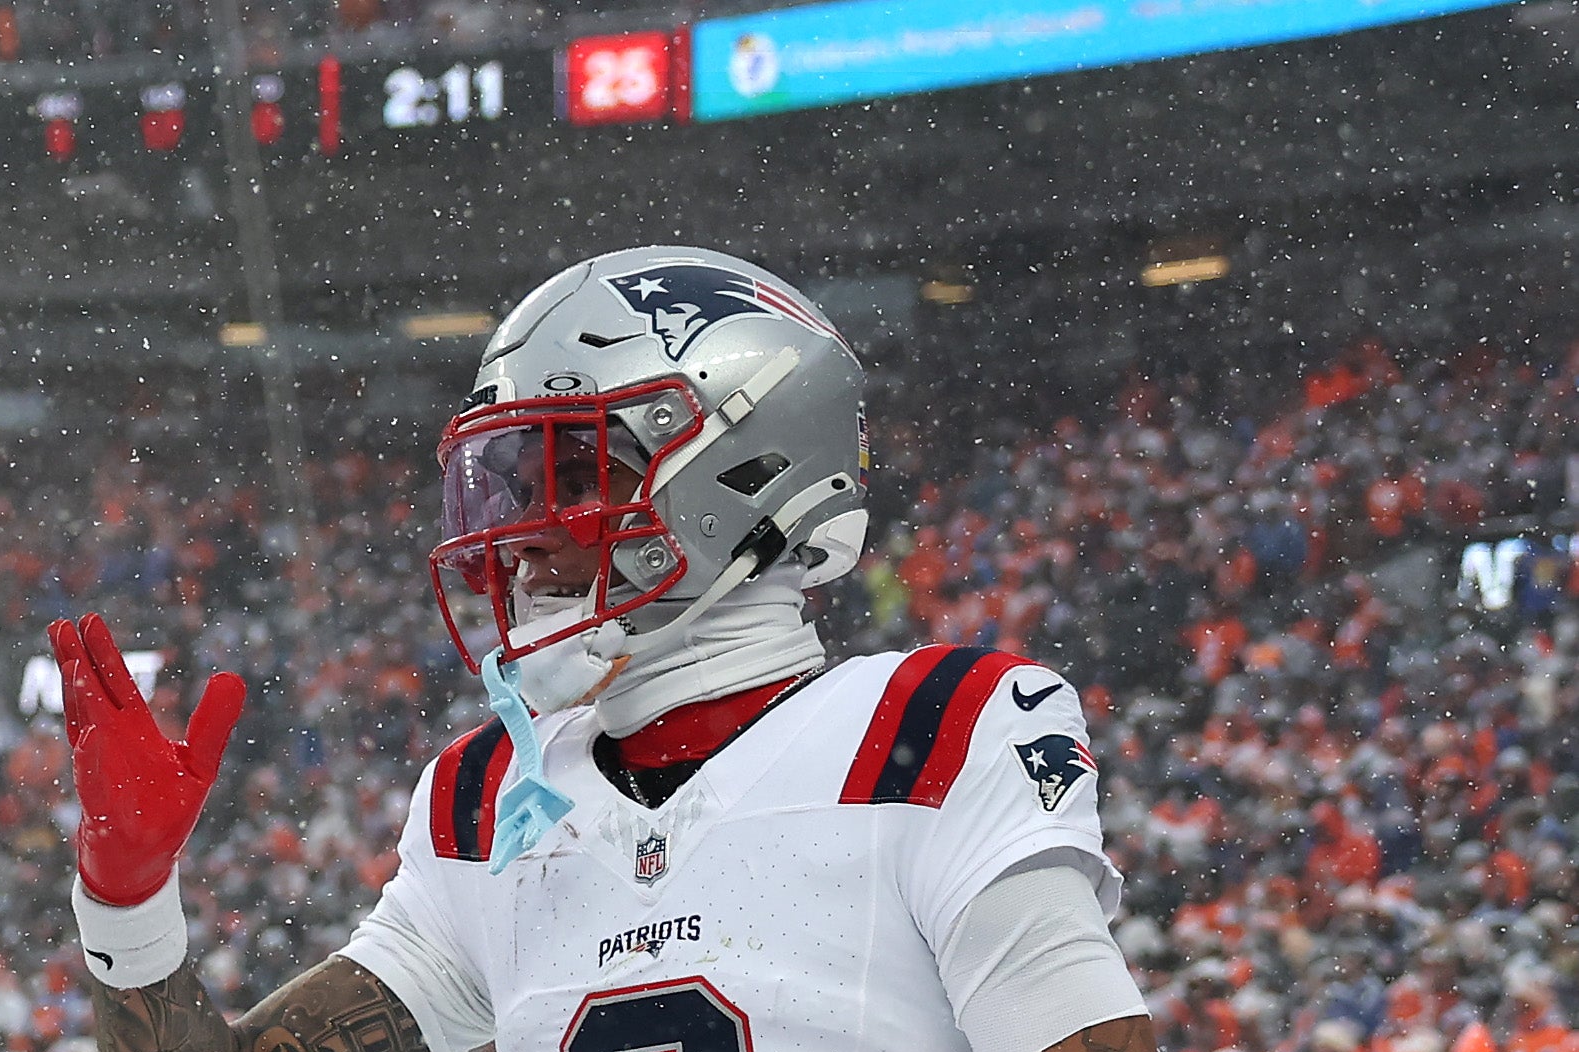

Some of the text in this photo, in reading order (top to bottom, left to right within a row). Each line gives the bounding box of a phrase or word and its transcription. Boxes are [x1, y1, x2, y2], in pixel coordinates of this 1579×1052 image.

[382, 60, 504, 129] 2:11
[581, 49, 658, 110] 25
[638, 853, 663, 876] NFL
[598, 914, 702, 968] PATRIOTS
